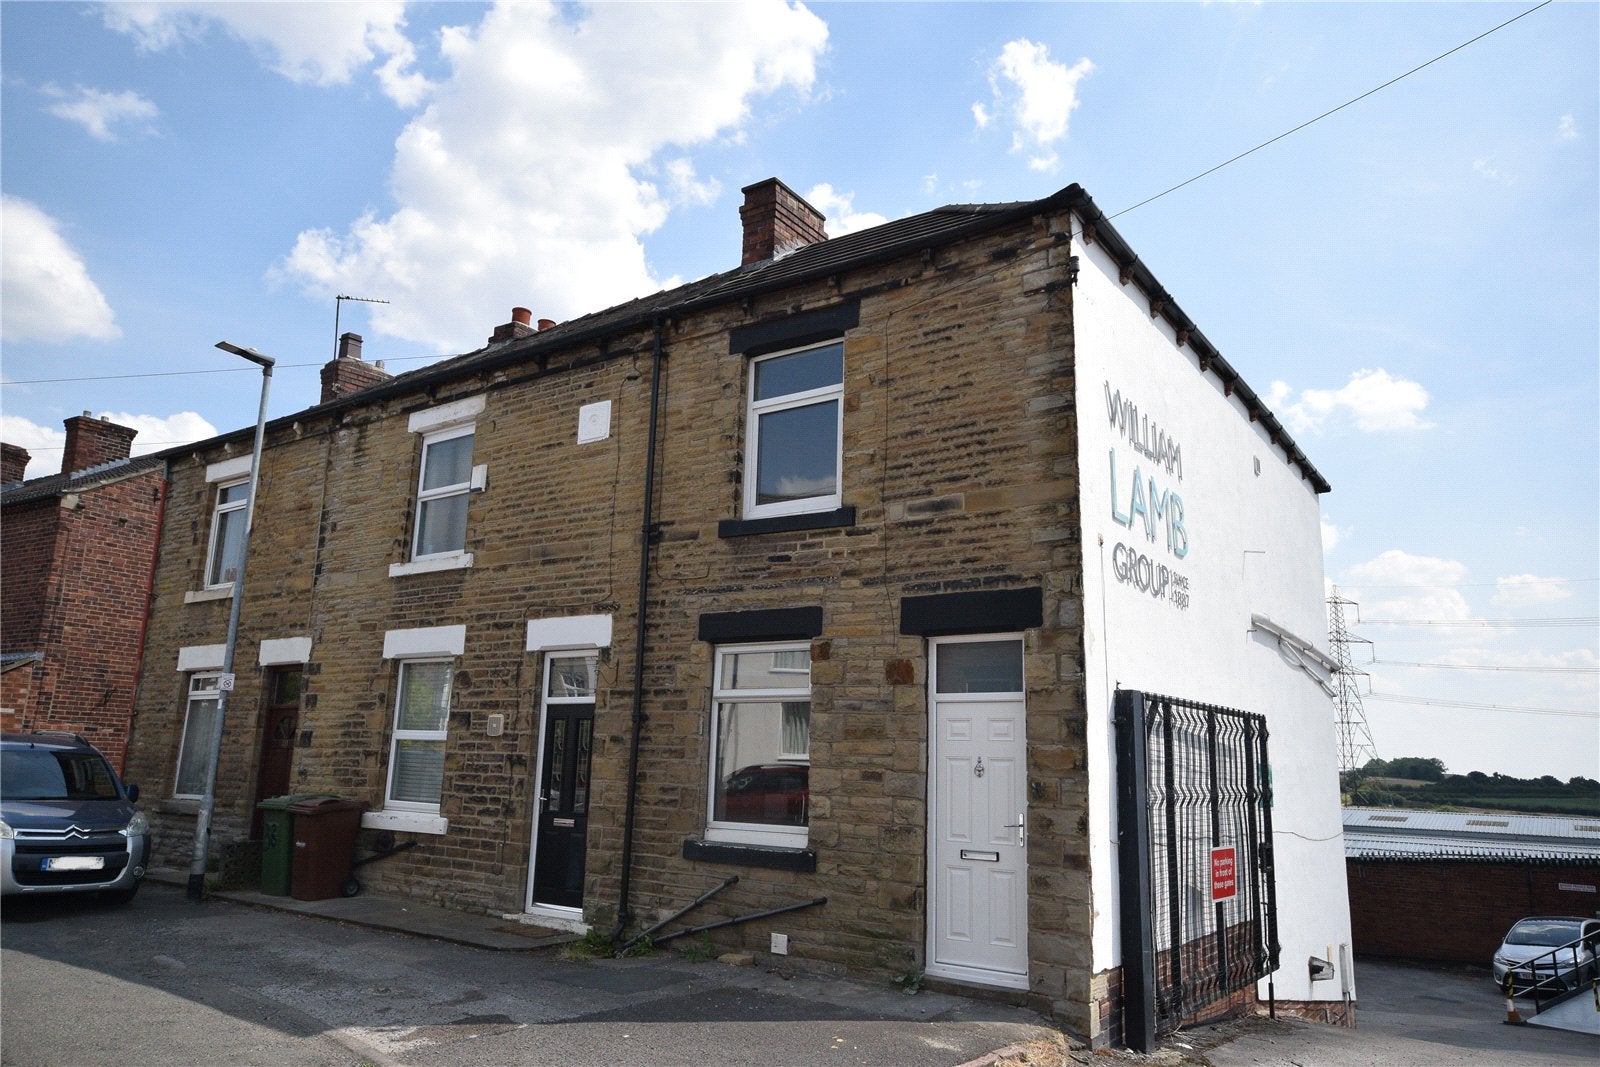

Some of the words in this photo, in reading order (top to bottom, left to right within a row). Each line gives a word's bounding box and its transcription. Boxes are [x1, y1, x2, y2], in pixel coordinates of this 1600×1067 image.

[1103, 380, 1182, 483] WILLIAM
[1109, 447, 1188, 559] LAMB
[1112, 542, 1169, 600] GROUP
[1220, 857, 1233, 867] parking
[1220, 868, 1228, 877] front
[1214, 880, 1224, 889] these
[1224, 879, 1234, 889] gates
